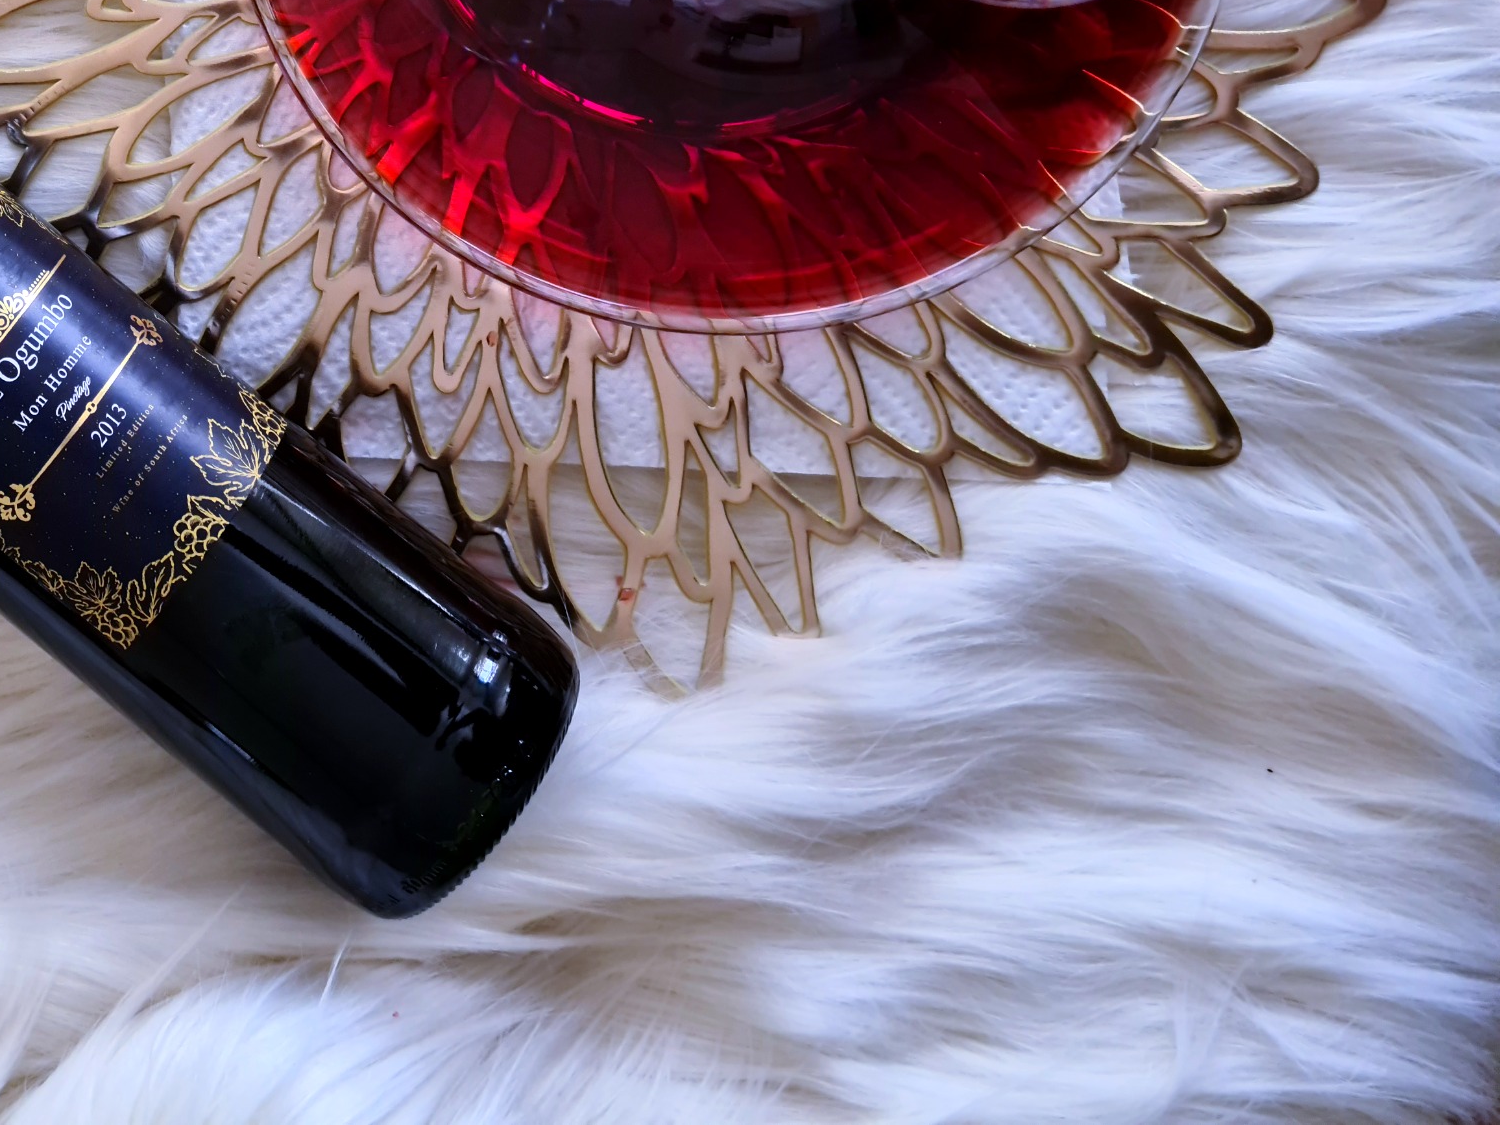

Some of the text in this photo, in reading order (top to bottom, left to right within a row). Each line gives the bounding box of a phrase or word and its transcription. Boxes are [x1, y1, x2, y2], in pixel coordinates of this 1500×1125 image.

[12, 335, 92, 432] Mon Homme
[55, 376, 92, 422] Pinotage
[90, 403, 127, 448] 2013
[96, 404, 155, 479] Limited Edition
[112, 414, 188, 513] Wine of South Africa
